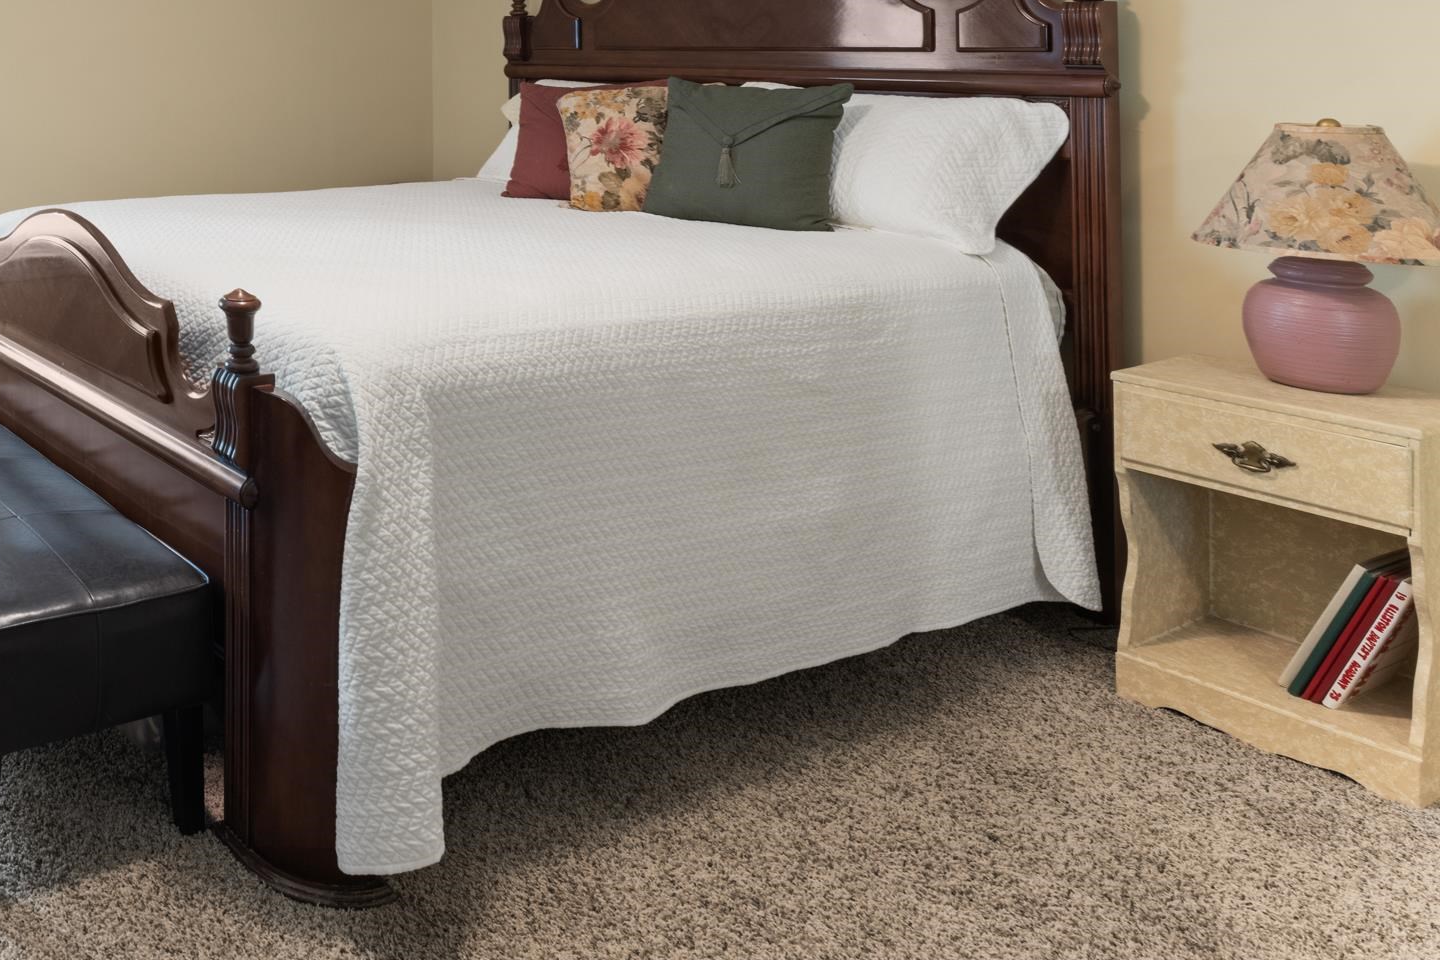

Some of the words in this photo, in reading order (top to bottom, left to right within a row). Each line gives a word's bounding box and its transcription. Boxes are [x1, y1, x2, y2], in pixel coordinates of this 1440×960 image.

[1395, 591, 1408, 601] 19
[1358, 630, 1380, 660] BAPTIST
[1337, 660, 1361, 690] ACADEMY
[1329, 690, 1342, 701] 75
